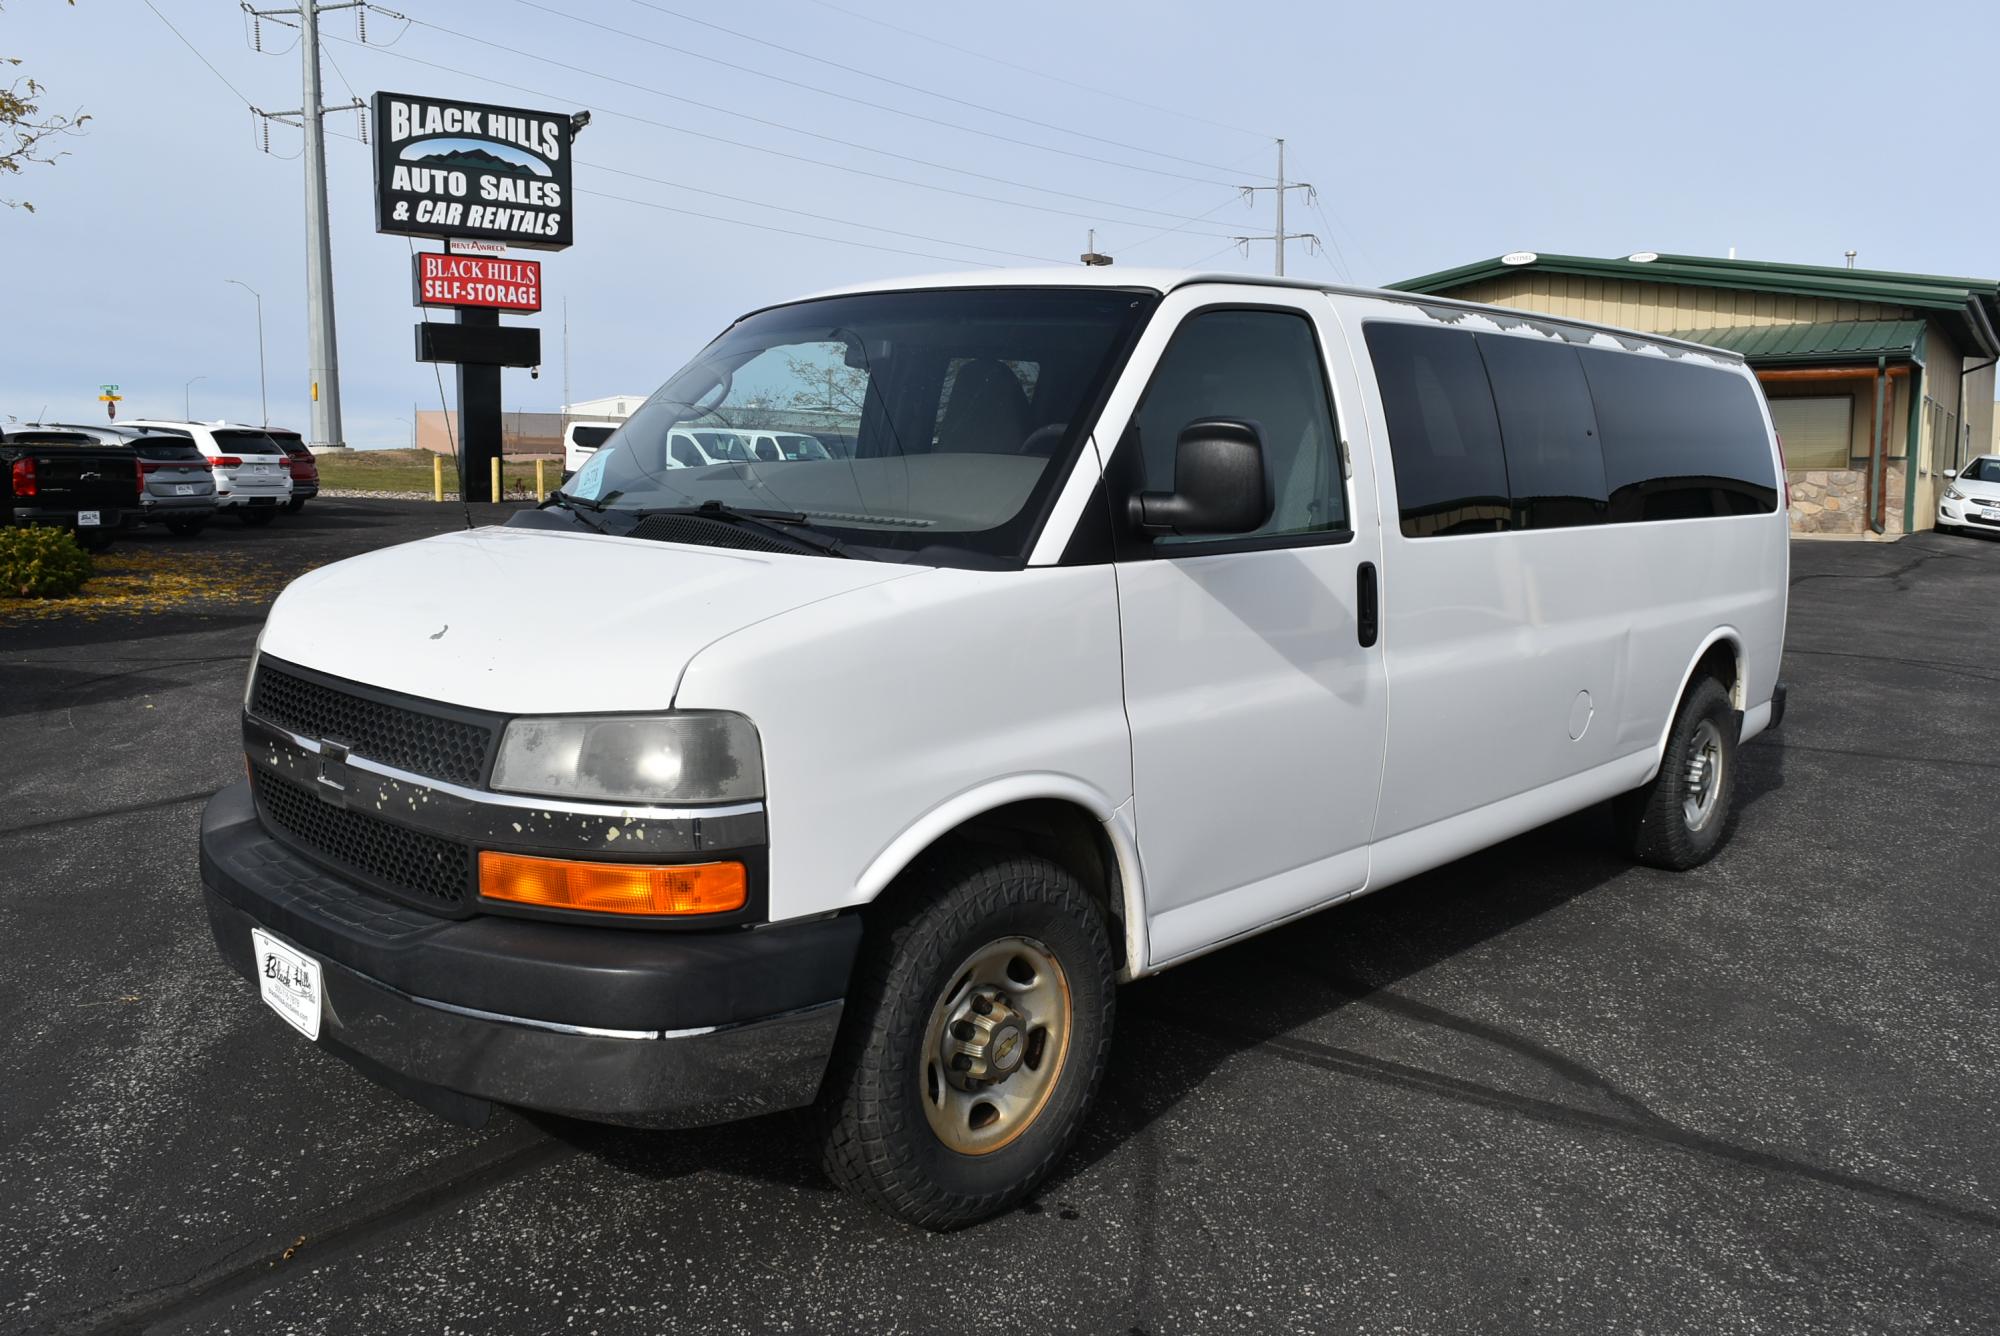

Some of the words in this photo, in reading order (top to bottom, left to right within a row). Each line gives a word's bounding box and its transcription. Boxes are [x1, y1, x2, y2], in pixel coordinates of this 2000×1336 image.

[390, 100, 483, 142] BLACK
[488, 114, 560, 161] HILLS
[391, 165, 467, 197] AUTO
[480, 174, 561, 208] SALES
[392, 201, 410, 221] &
[416, 200, 463, 226] CAR
[466, 205, 561, 236] RENTALS
[425, 257, 483, 279] BLACK
[488, 262, 536, 286] HILLS
[425, 280, 536, 305] SELF-STORAGE
